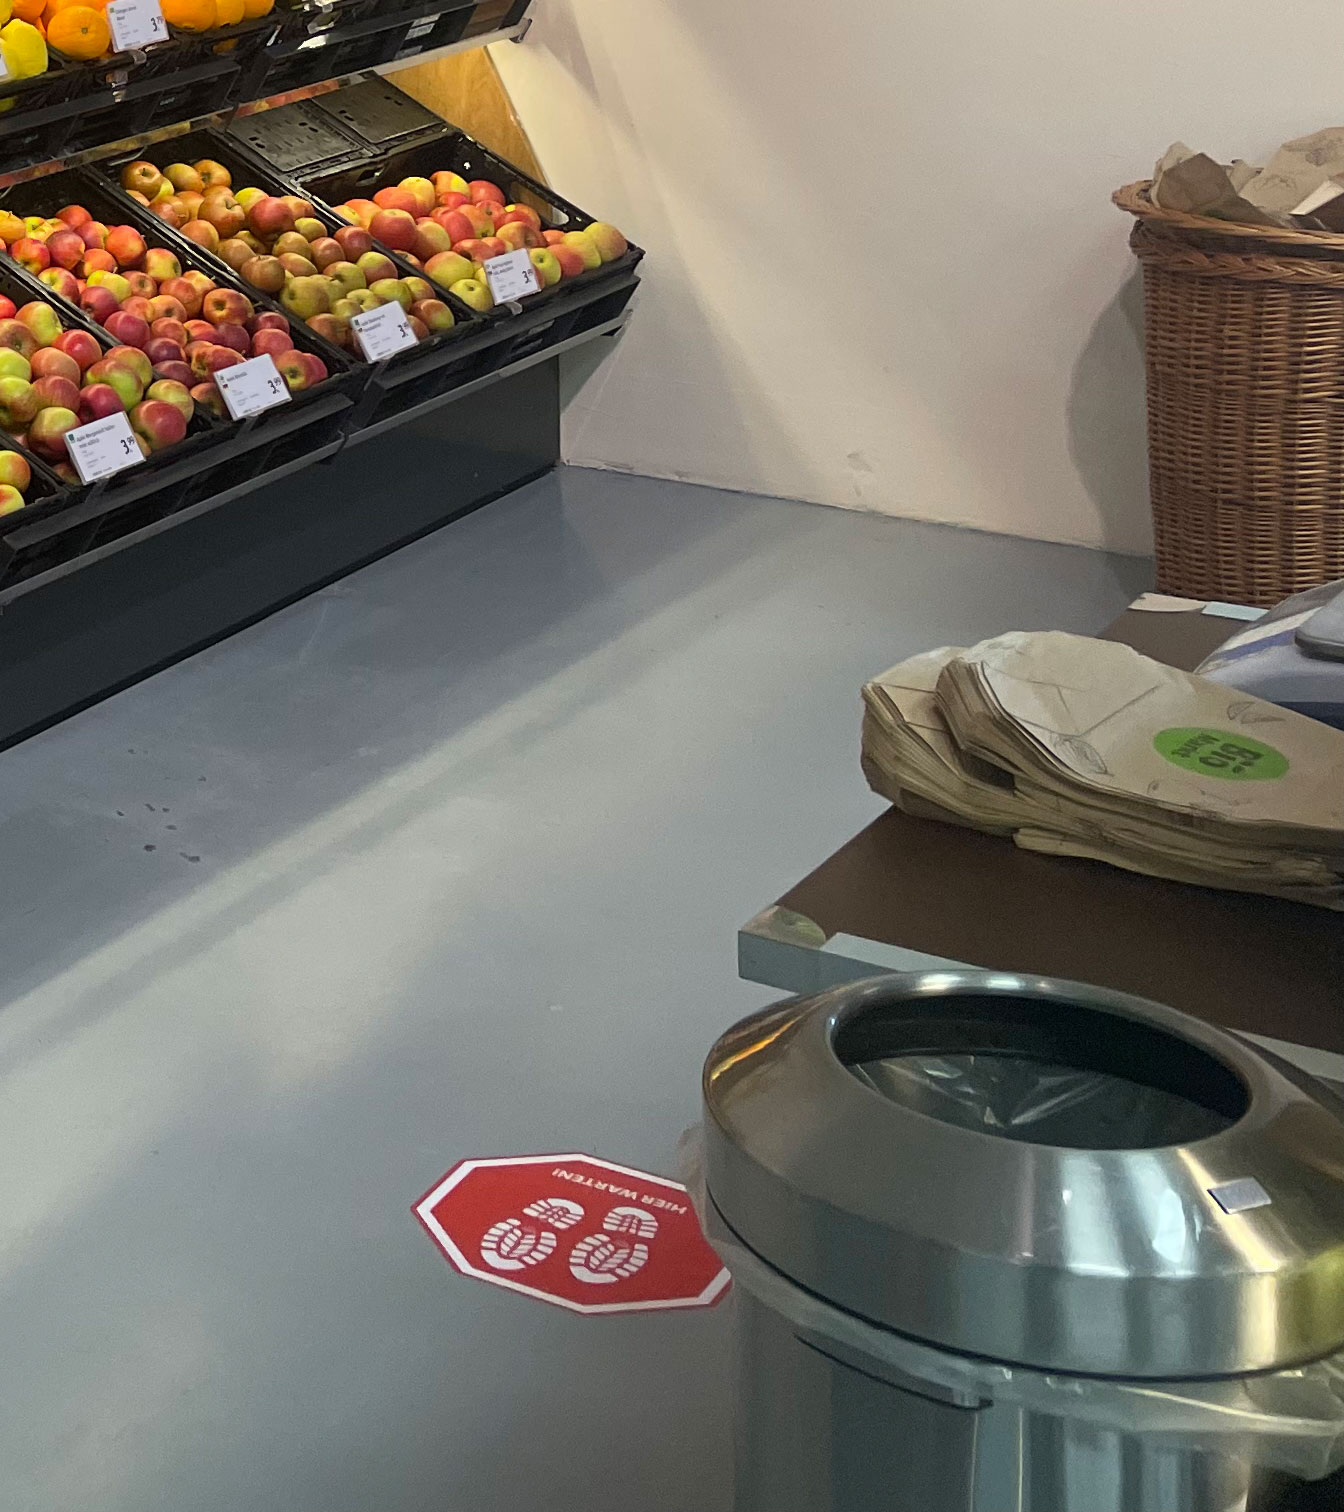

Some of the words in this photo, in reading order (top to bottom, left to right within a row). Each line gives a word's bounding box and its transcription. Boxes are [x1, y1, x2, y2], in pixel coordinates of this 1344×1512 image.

[1171, 733, 1220, 758] Markt
[552, 1168, 638, 1201] WARTEN!
[641, 1194, 688, 1215] HIER
